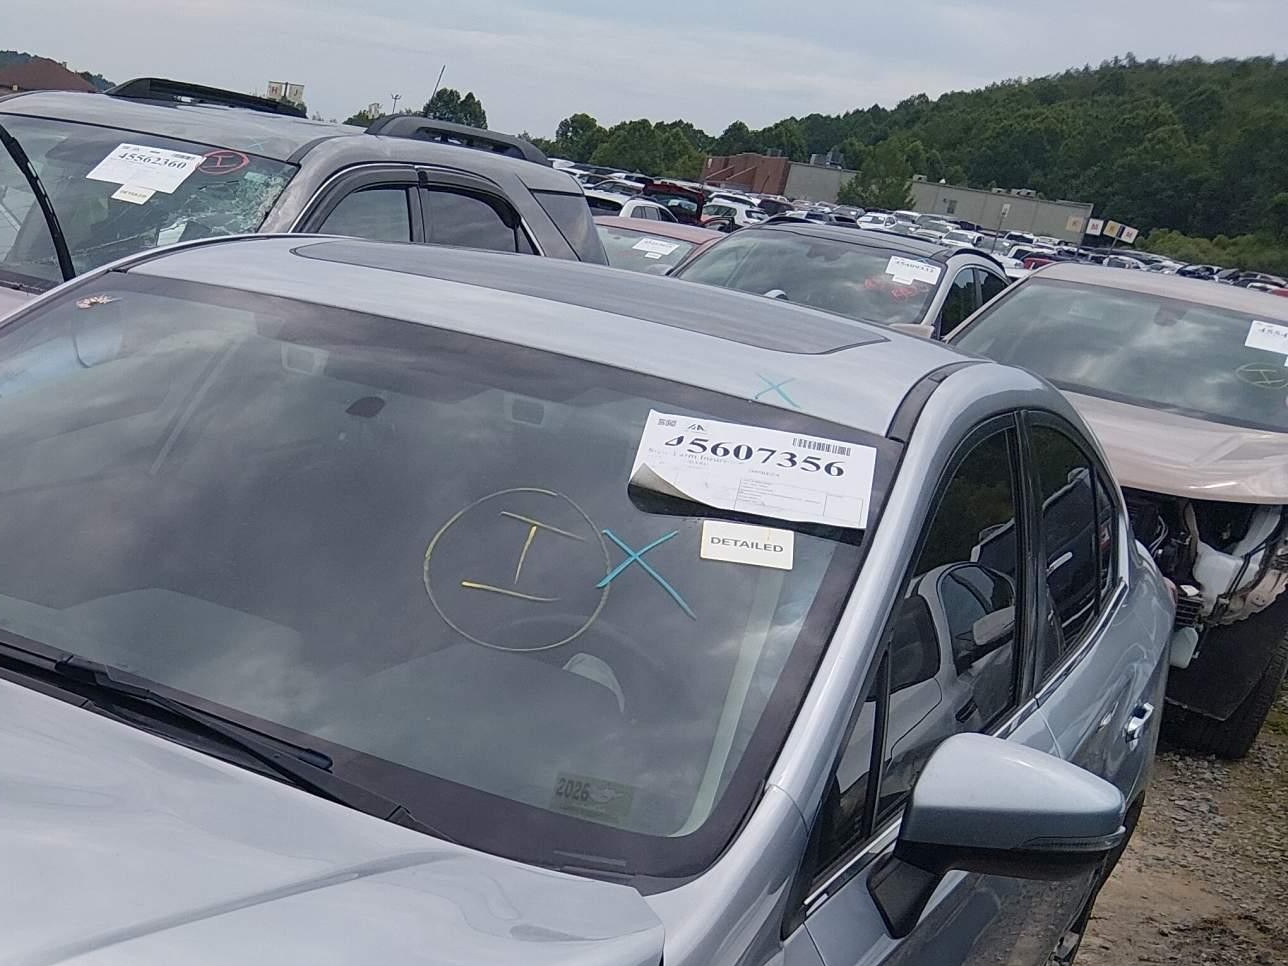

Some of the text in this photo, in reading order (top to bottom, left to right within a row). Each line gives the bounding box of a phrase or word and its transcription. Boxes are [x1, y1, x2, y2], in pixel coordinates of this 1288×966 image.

[118, 152, 188, 170] 45562360
[664, 435, 846, 478] 45607356
[709, 535, 785, 555] DETAILED
